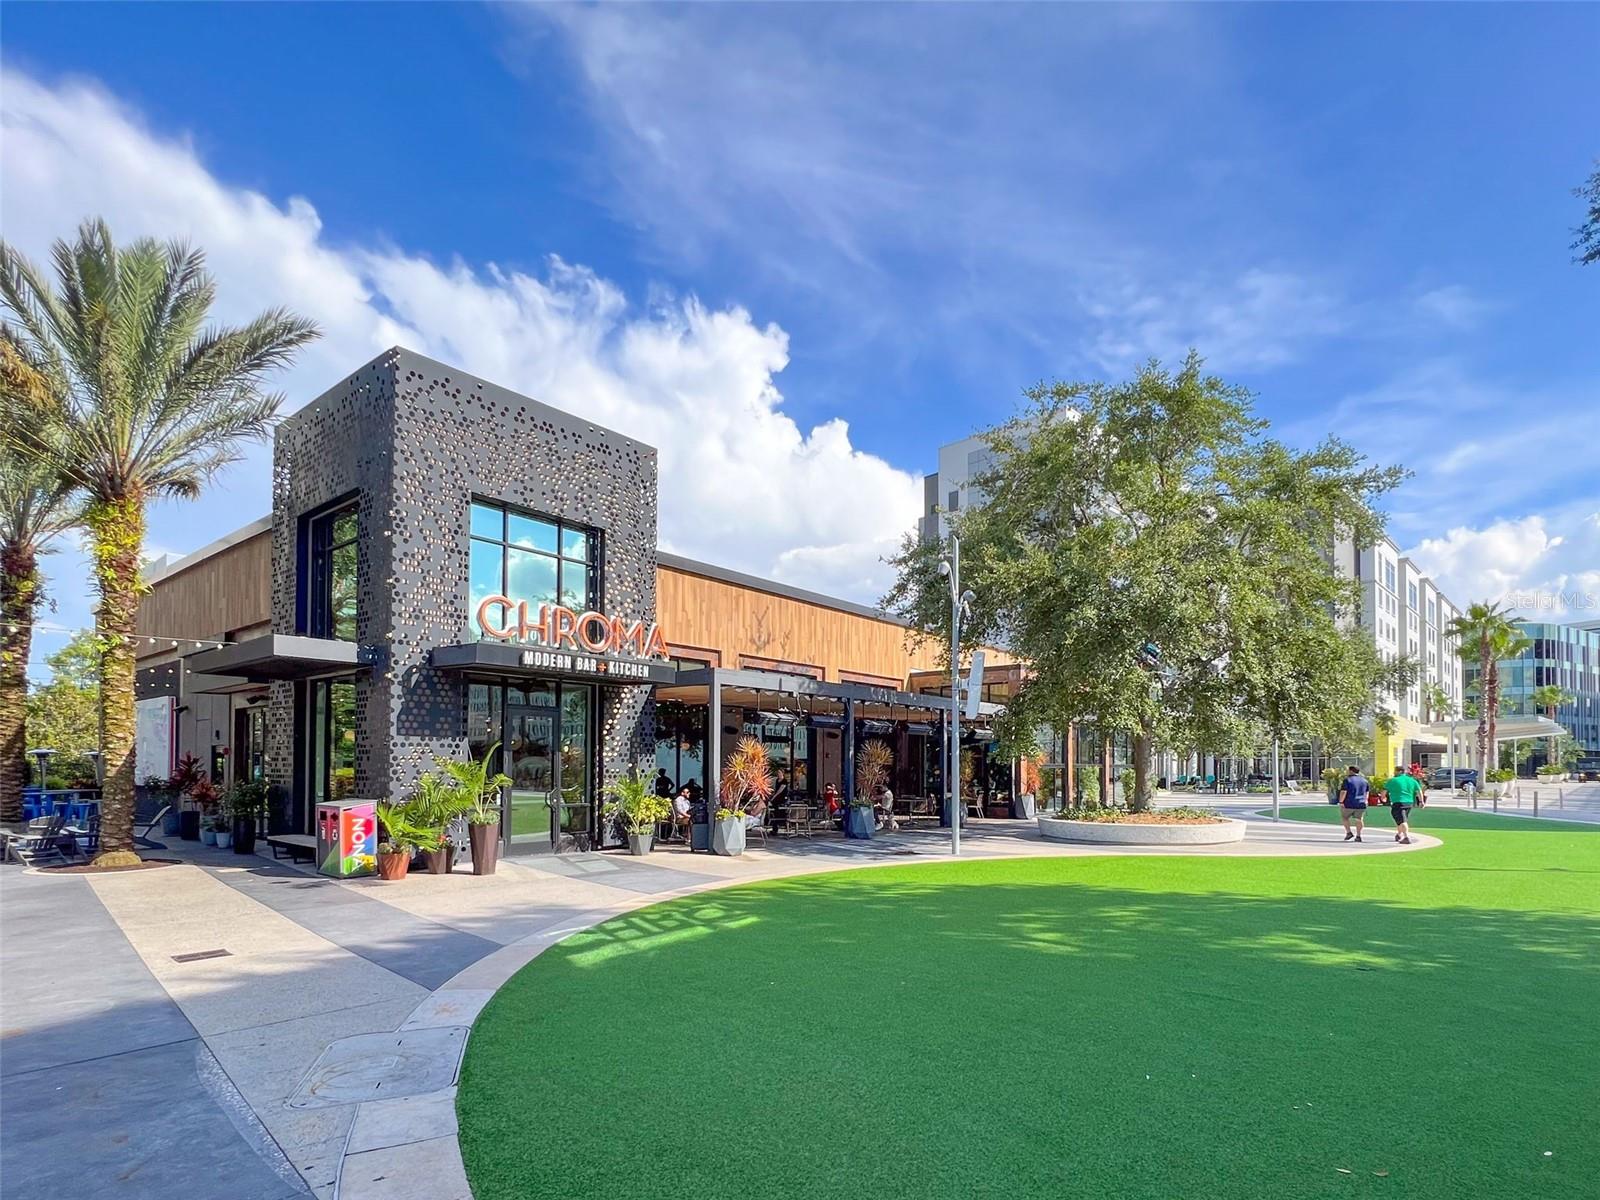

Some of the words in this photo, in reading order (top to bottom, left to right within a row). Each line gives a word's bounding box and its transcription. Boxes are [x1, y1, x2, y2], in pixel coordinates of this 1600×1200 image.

[476, 594, 671, 663] CHROMA
[523, 651, 572, 668] MODERN
[576, 657, 597, 672] BAR
[609, 661, 650, 677] KITCHEN
[351, 818, 366, 872] NONA
